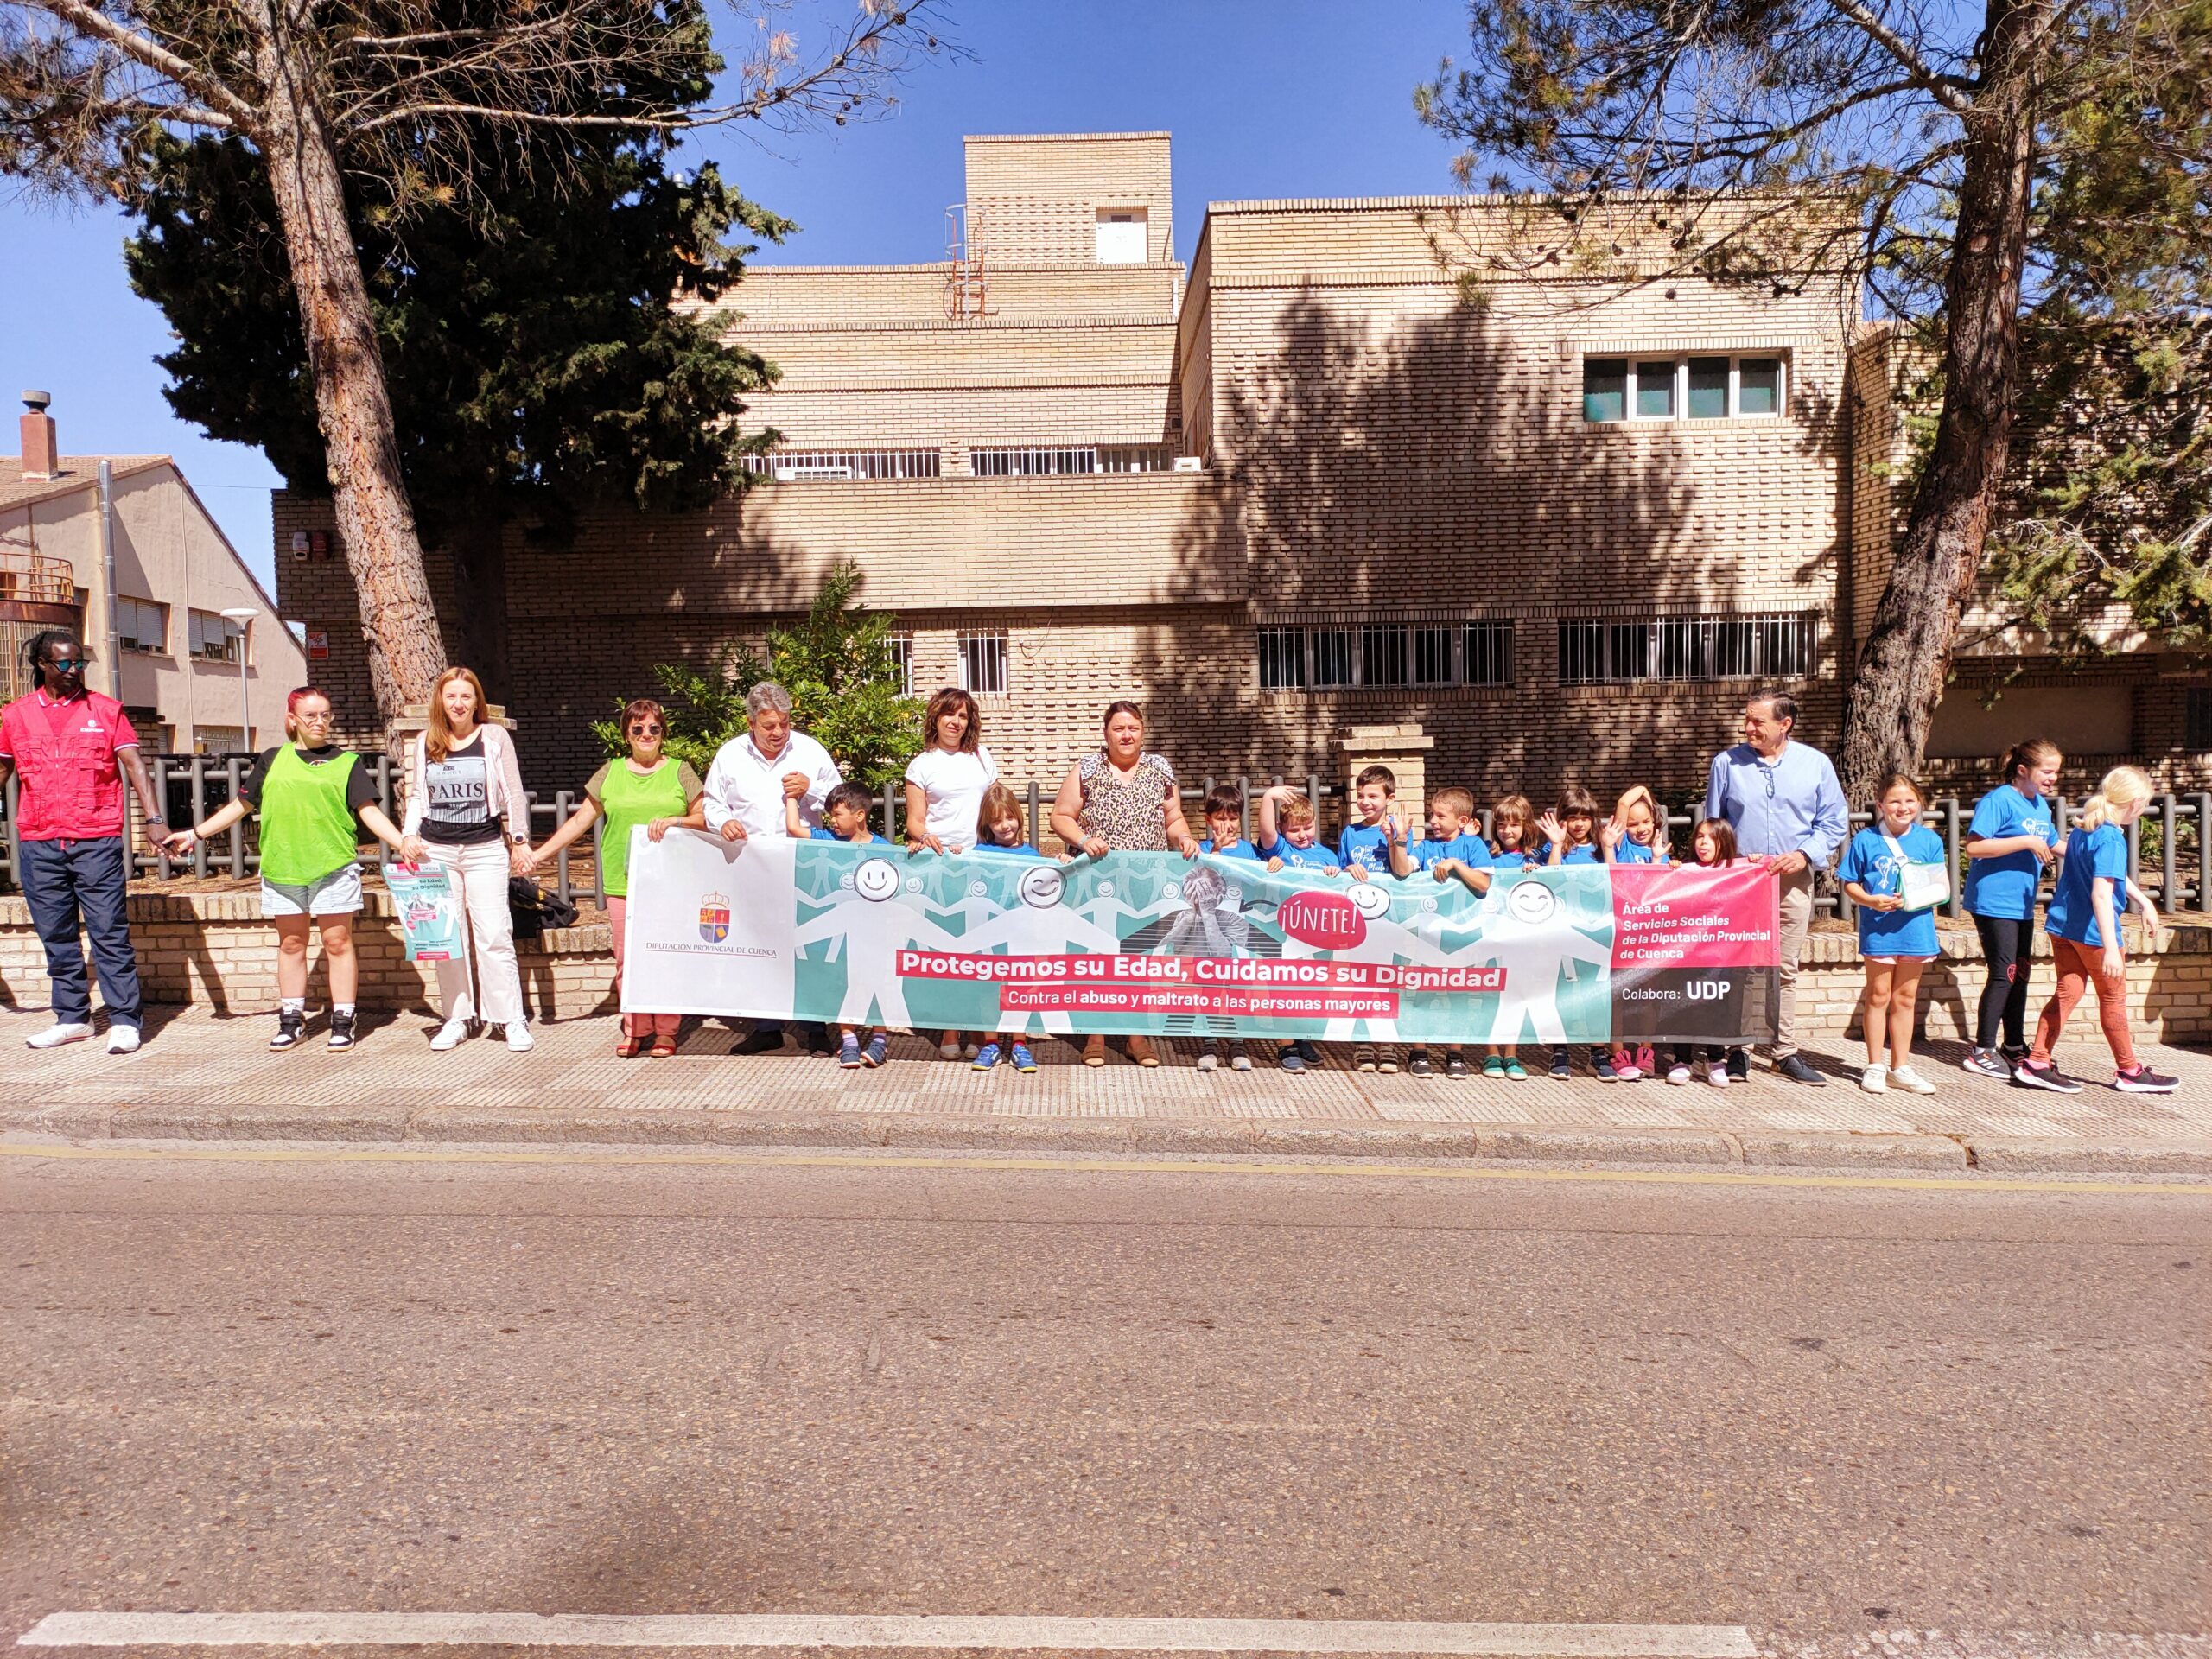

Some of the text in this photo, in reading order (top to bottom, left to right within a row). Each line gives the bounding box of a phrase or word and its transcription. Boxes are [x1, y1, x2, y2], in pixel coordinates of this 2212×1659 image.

[428, 783, 483, 799] PARIS
[1281, 899, 1357, 934] ¡ÚNETE!
[1623, 902, 1669, 915] Área de
[1624, 915, 1730, 931] Servicios Sociales
[1622, 930, 1770, 945] de la Diputación Provincial
[645, 942, 691, 950] DIPUTACIÓN
[694, 944, 734, 953] PROVINCIAL
[1620, 949, 1684, 959] de Cuenca
[902, 952, 1501, 990] Protegemos su Edad, Cuidamos su Dignidad
[1622, 981, 1731, 1001] Colabora: UDP
[1008, 990, 1391, 1014] Contra el abuso y maltrato a las personas mayores
